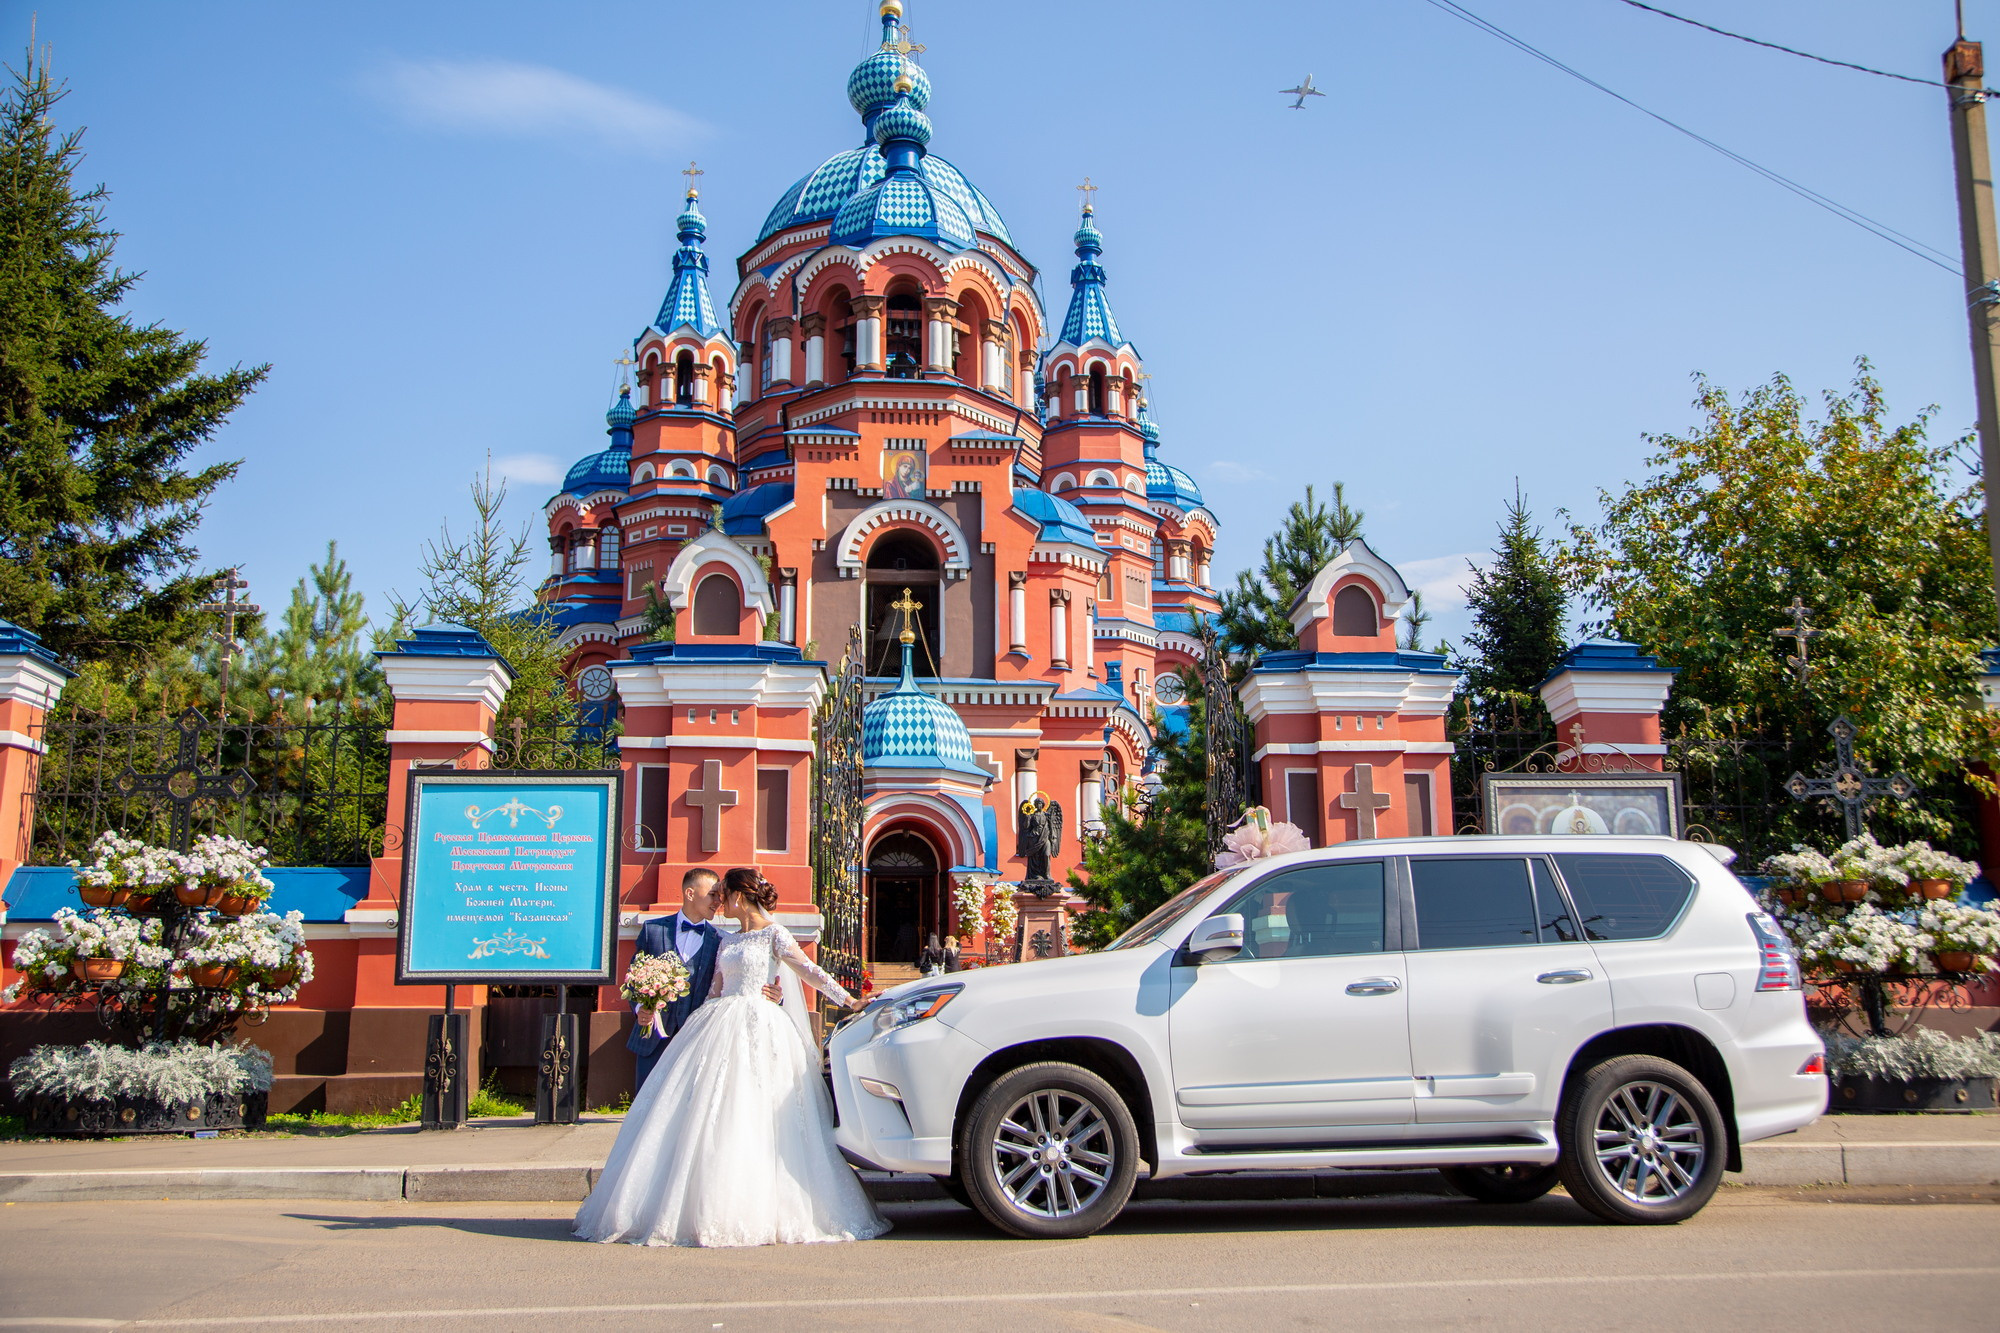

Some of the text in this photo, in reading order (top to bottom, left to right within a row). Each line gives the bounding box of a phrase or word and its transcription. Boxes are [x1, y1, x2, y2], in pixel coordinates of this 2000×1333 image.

[434, 832, 593, 844] Русская Православная Церковь
[450, 846, 576, 858] Московский Патриархат
[451, 861, 573, 873] Иркутская Митрополия
[454, 882, 482, 893] Храм
[499, 884, 529, 892] честь
[535, 882, 568, 892] Иконы
[465, 897, 504, 907] Божией
[447, 911, 573, 924] именуемой "Казанская"
